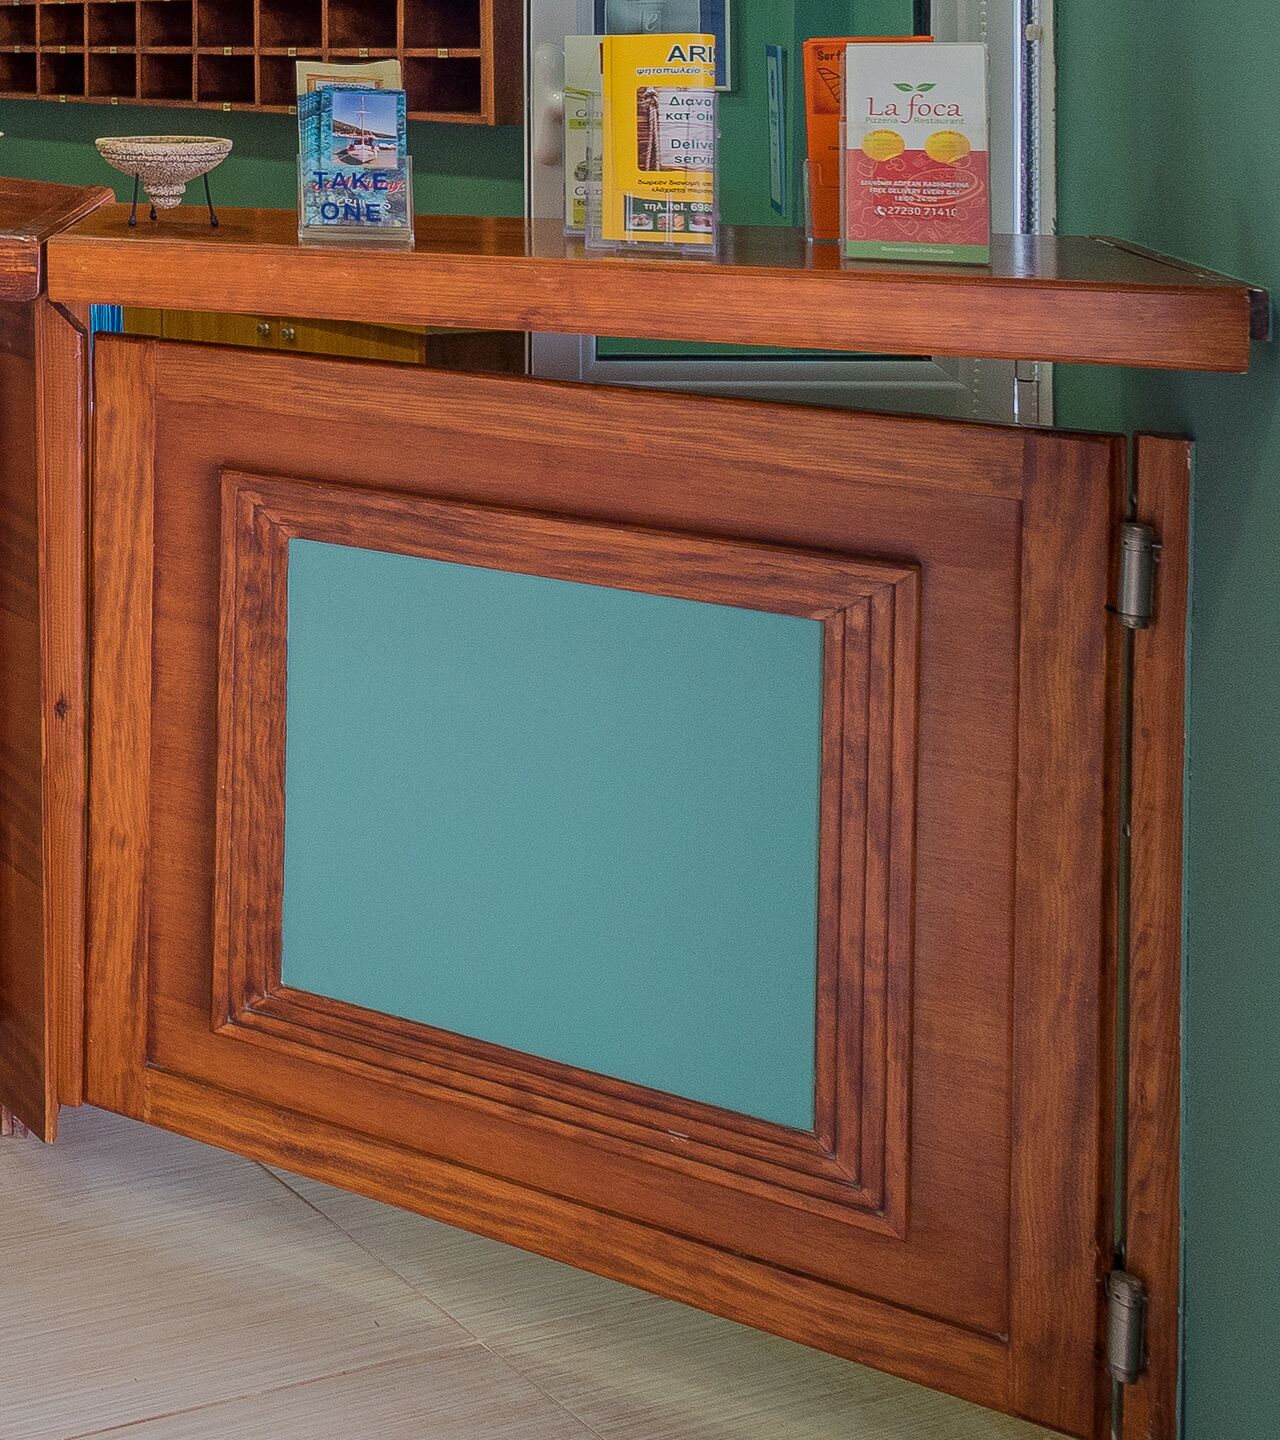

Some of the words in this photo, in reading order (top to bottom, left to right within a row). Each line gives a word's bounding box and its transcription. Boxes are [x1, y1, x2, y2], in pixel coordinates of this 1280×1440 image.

[667, 45, 715, 63] ARI
[866, 97, 900, 116] La
[900, 94, 963, 124] foca
[913, 117, 965, 125] Restaurant
[313, 171, 388, 191] TAKE
[320, 201, 382, 222] ONE
